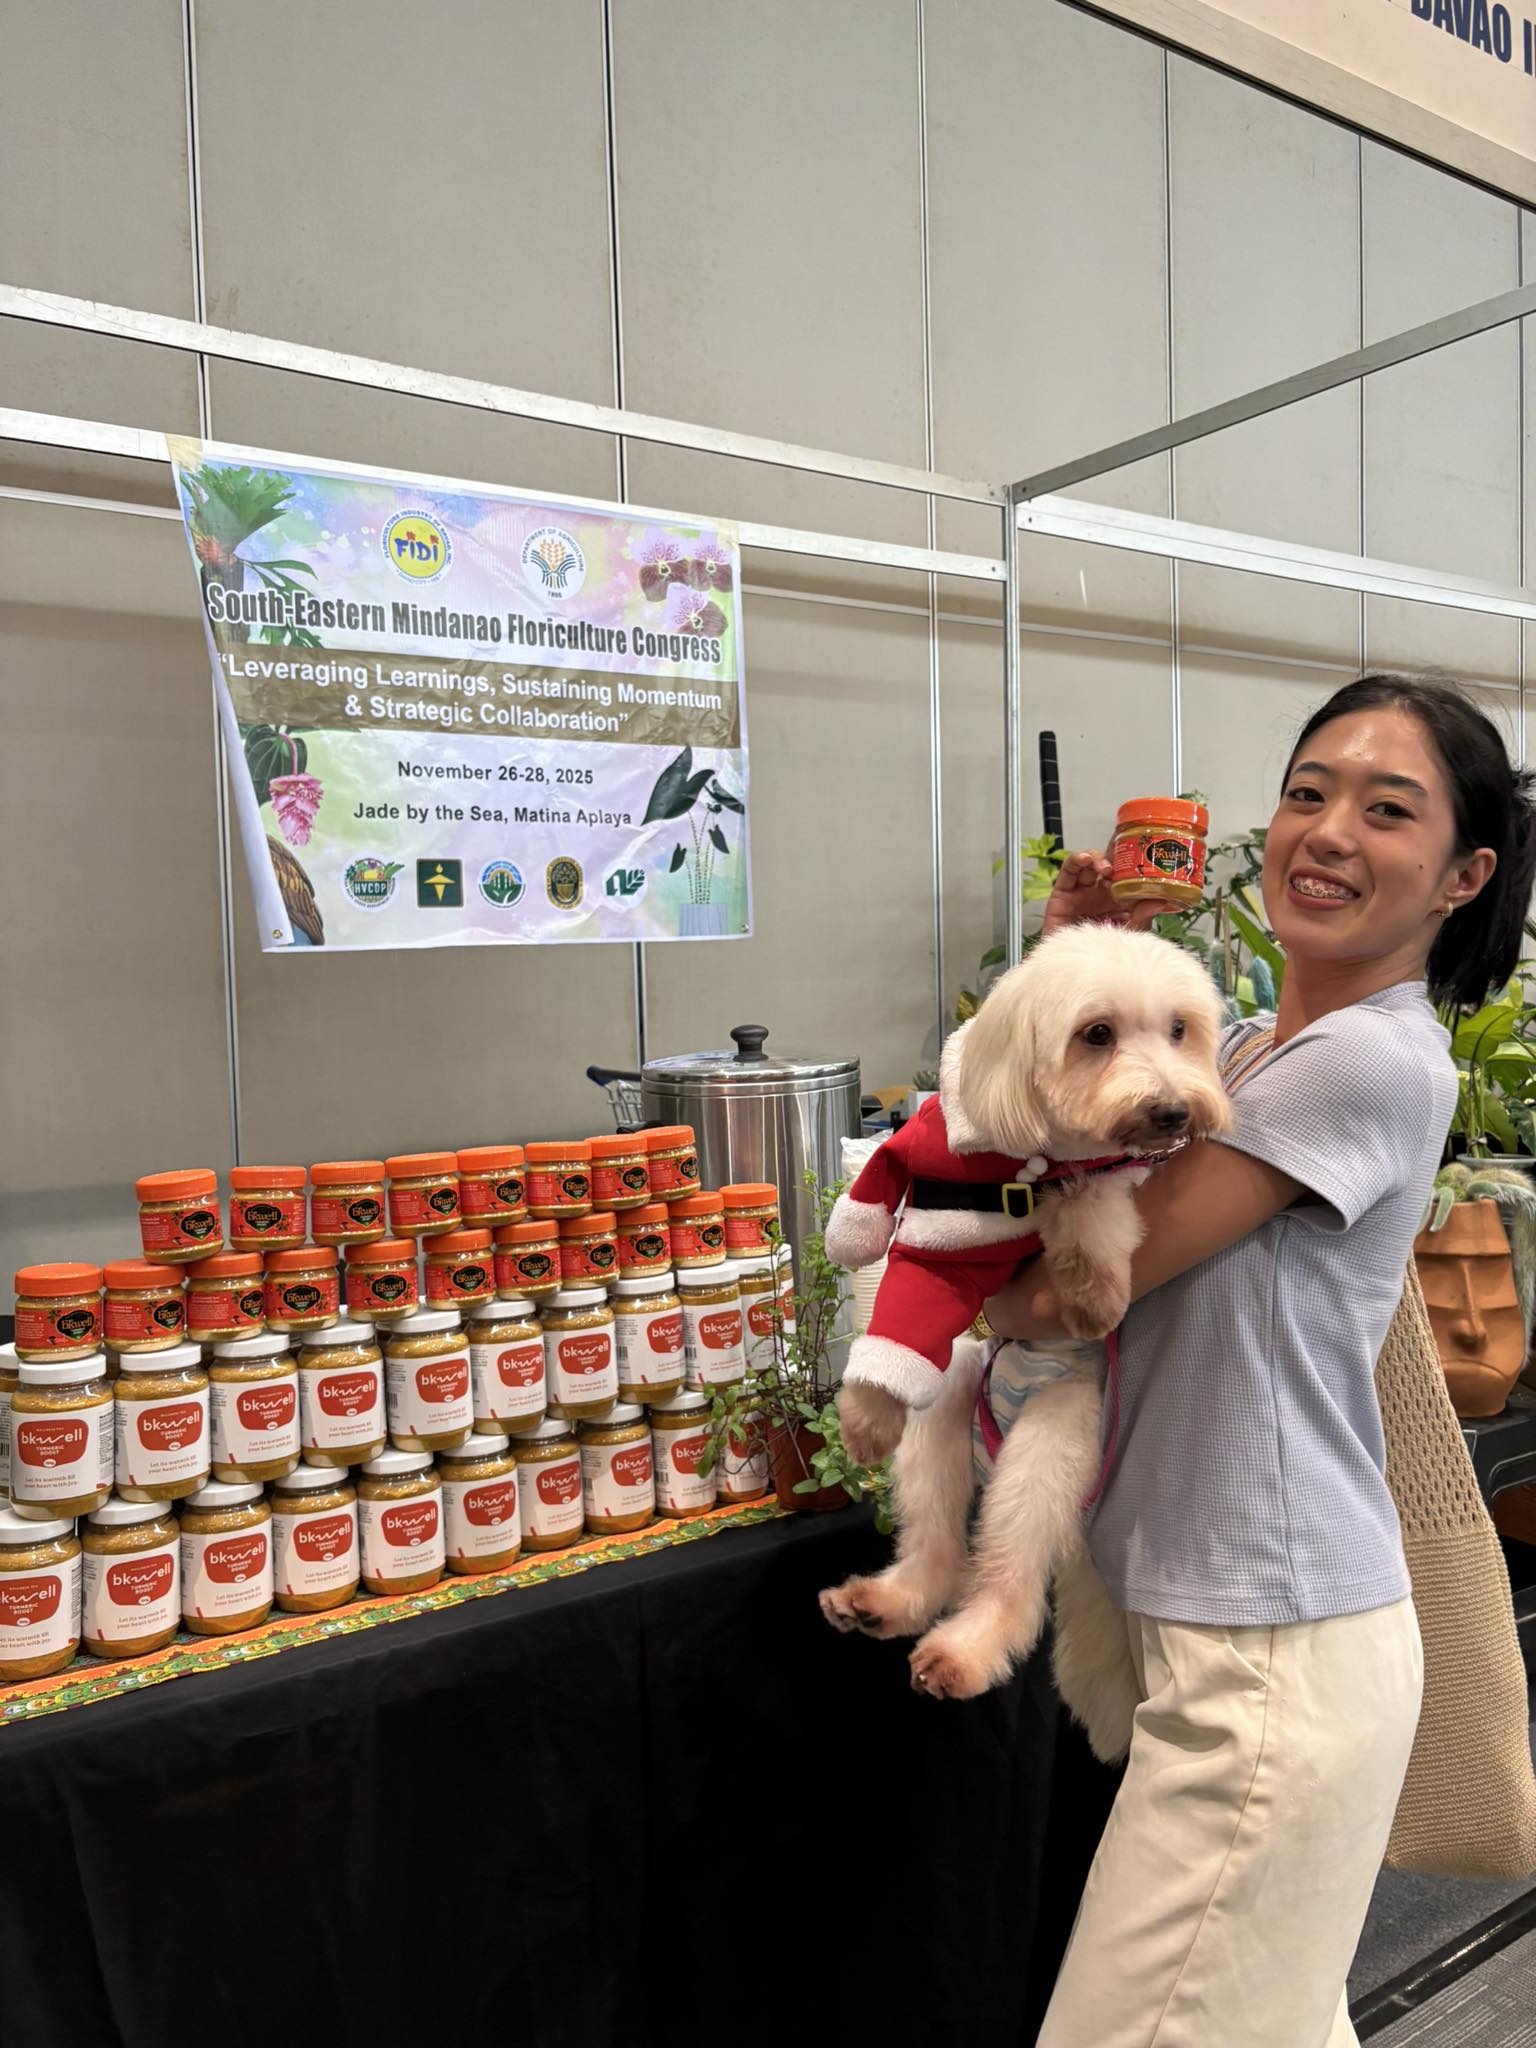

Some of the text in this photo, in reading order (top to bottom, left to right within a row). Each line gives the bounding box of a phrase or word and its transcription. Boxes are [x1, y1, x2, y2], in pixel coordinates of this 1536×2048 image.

[521, 528, 546, 564] DEPARTMENT
[558, 531, 584, 572] AGRICULTURE
[209, 584, 721, 663] South-Eastern Mindanao Floriculture Congress
[376, 663, 497, 696] Learnings,
[502, 673, 612, 705] Sustaining
[617, 683, 722, 709] Momentum
[345, 694, 363, 717] &
[370, 696, 473, 725] Strategic
[397, 761, 594, 785] November 26-28, 2025
[353, 802, 632, 827] Jade by the Sea, Matina Aplaya
[562, 1340, 609, 1358] bkwell
[322, 1379, 375, 1398] bkwell
[242, 1391, 294, 1412] bkwell
[143, 1409, 200, 1431] bkwell
[21, 1427, 82, 1445] bkwell
[386, 1507, 436, 1529] bkwell
[298, 1520, 351, 1544] bkwell
[209, 1540, 264, 1565] bkwell
[112, 1561, 171, 1586] bkwell
[0, 1584, 56, 1604] kwell
[9, 1602, 39, 1611] TURMERIC
